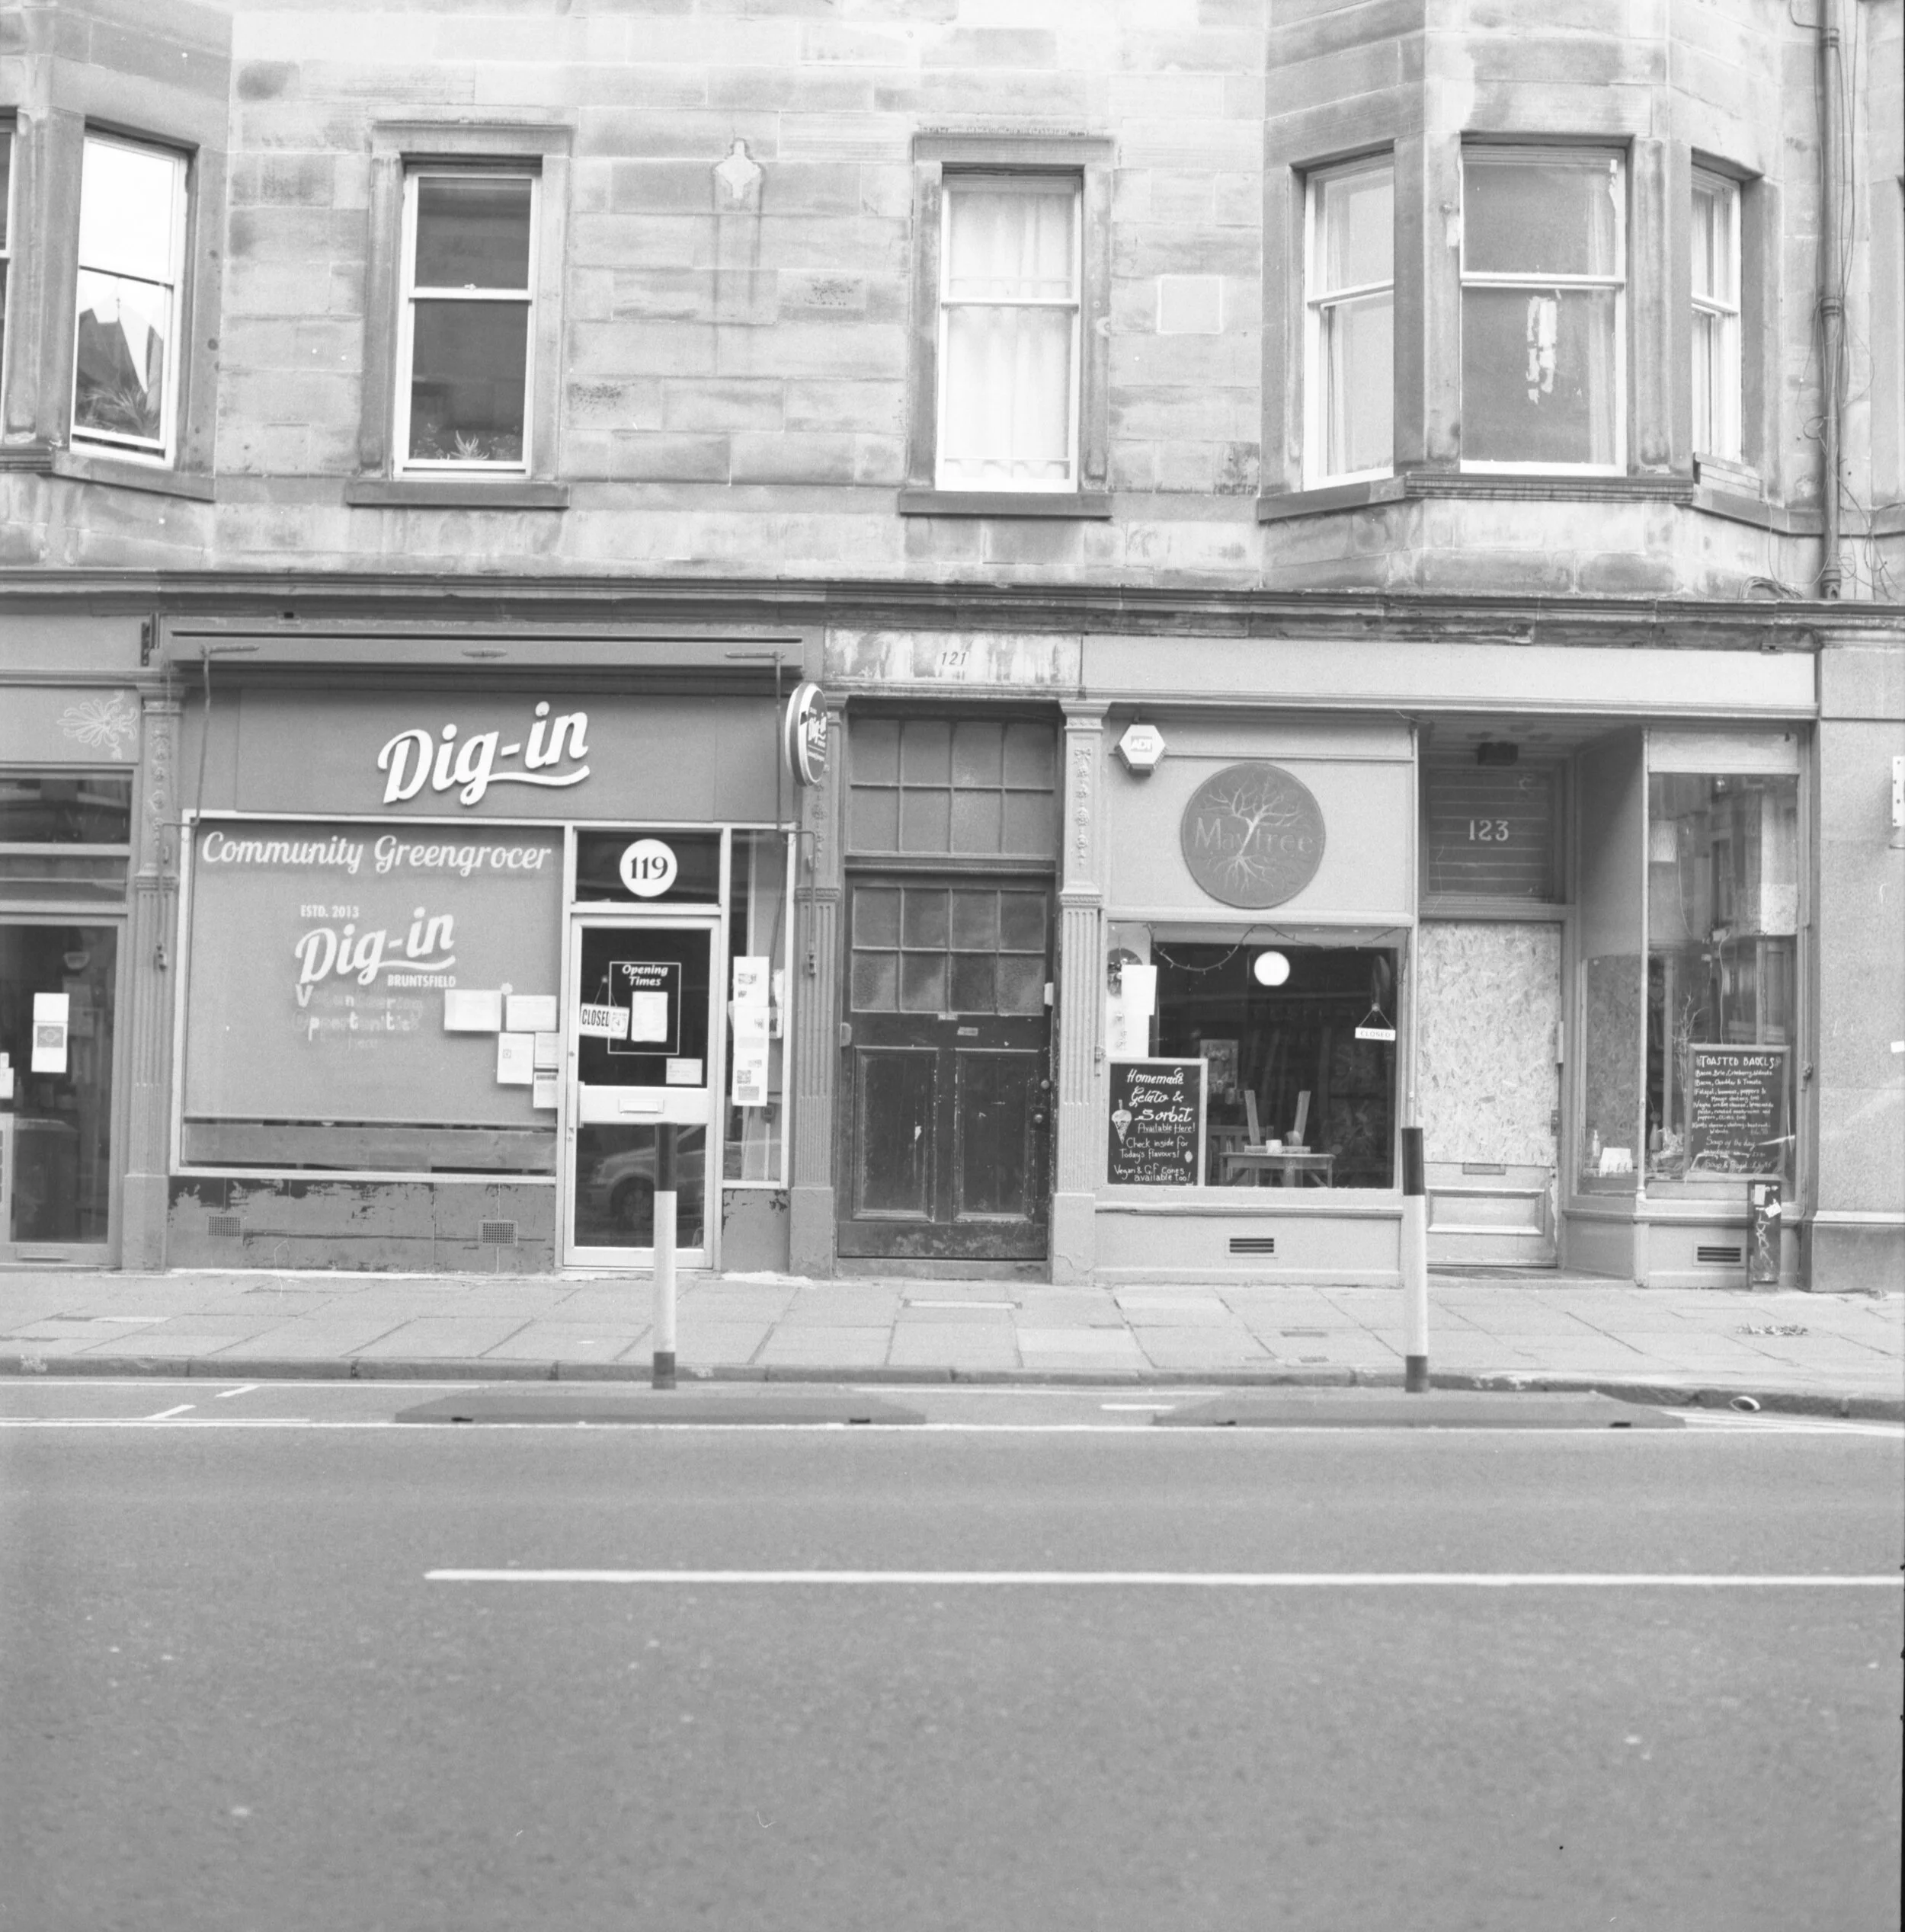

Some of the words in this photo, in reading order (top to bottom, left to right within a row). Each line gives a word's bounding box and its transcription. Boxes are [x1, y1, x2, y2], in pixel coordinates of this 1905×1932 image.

[940, 651, 968, 666] 121
[377, 699, 590, 804] Dig-in
[1468, 819, 1510, 841] 123
[201, 831, 363, 875] Community
[373, 834, 552, 877] Greengrocer
[629, 856, 669, 881] 119
[301, 904, 328, 918] ESTD.
[332, 905, 359, 918] 2013
[295, 907, 456, 985] Dig-in
[622, 964, 669, 977] Opening
[387, 974, 456, 988] BRUNTSFIELD
[629, 976, 662, 987] Times
[1360, 1030, 1391, 1038] CLOSED
[1699, 1055, 1739, 1068] TOASTED
[1126, 1067, 1184, 1085] Homemade
[1129, 1086, 1169, 1108] Gelato
[1172, 1090, 1184, 1102] &
[1134, 1105, 1194, 1123] Sorbet
[1138, 1123, 1172, 1134] Available
[1173, 1122, 1196, 1134] Here!
[1125, 1137, 1151, 1149] Check
[1154, 1138, 1174, 1147] inside
[1177, 1135, 1189, 1150] for
[1119, 1148, 1145, 1164] Today's
[1113, 1164, 1136, 1180] Vegan
[1136, 1166, 1142, 1174] &
[1134, 1172, 1172, 1182] available
[1174, 1172, 1192, 1182] too!
